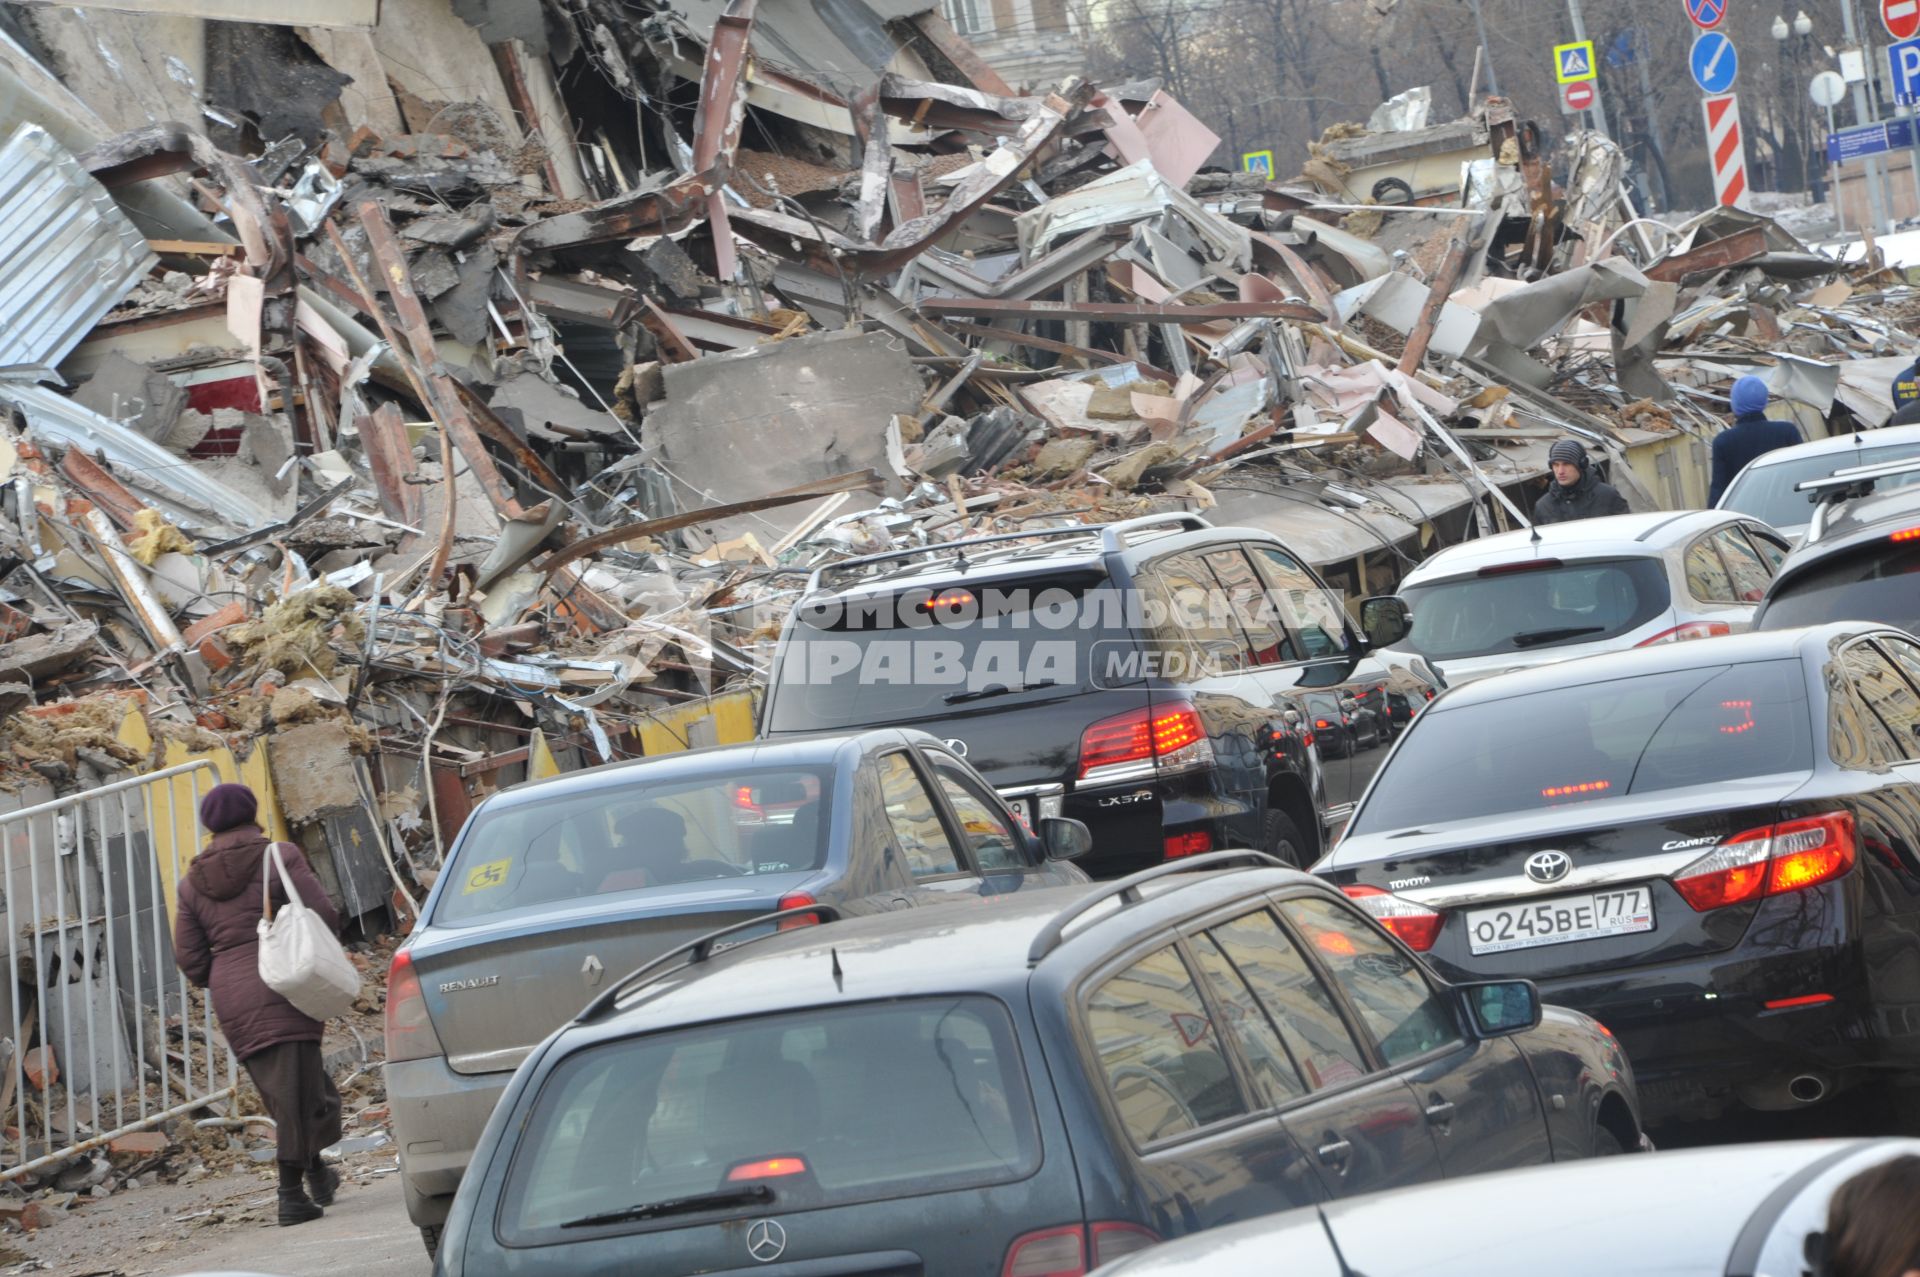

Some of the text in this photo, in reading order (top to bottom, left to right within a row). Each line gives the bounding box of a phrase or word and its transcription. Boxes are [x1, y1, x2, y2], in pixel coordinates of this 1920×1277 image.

[1662, 835, 1722, 850] CAMRY
[1390, 876, 1431, 889] TOYOTA
[1596, 890, 1640, 918] 777
[1610, 915, 1632, 926] RUS
[440, 975, 499, 993] RENAULT
